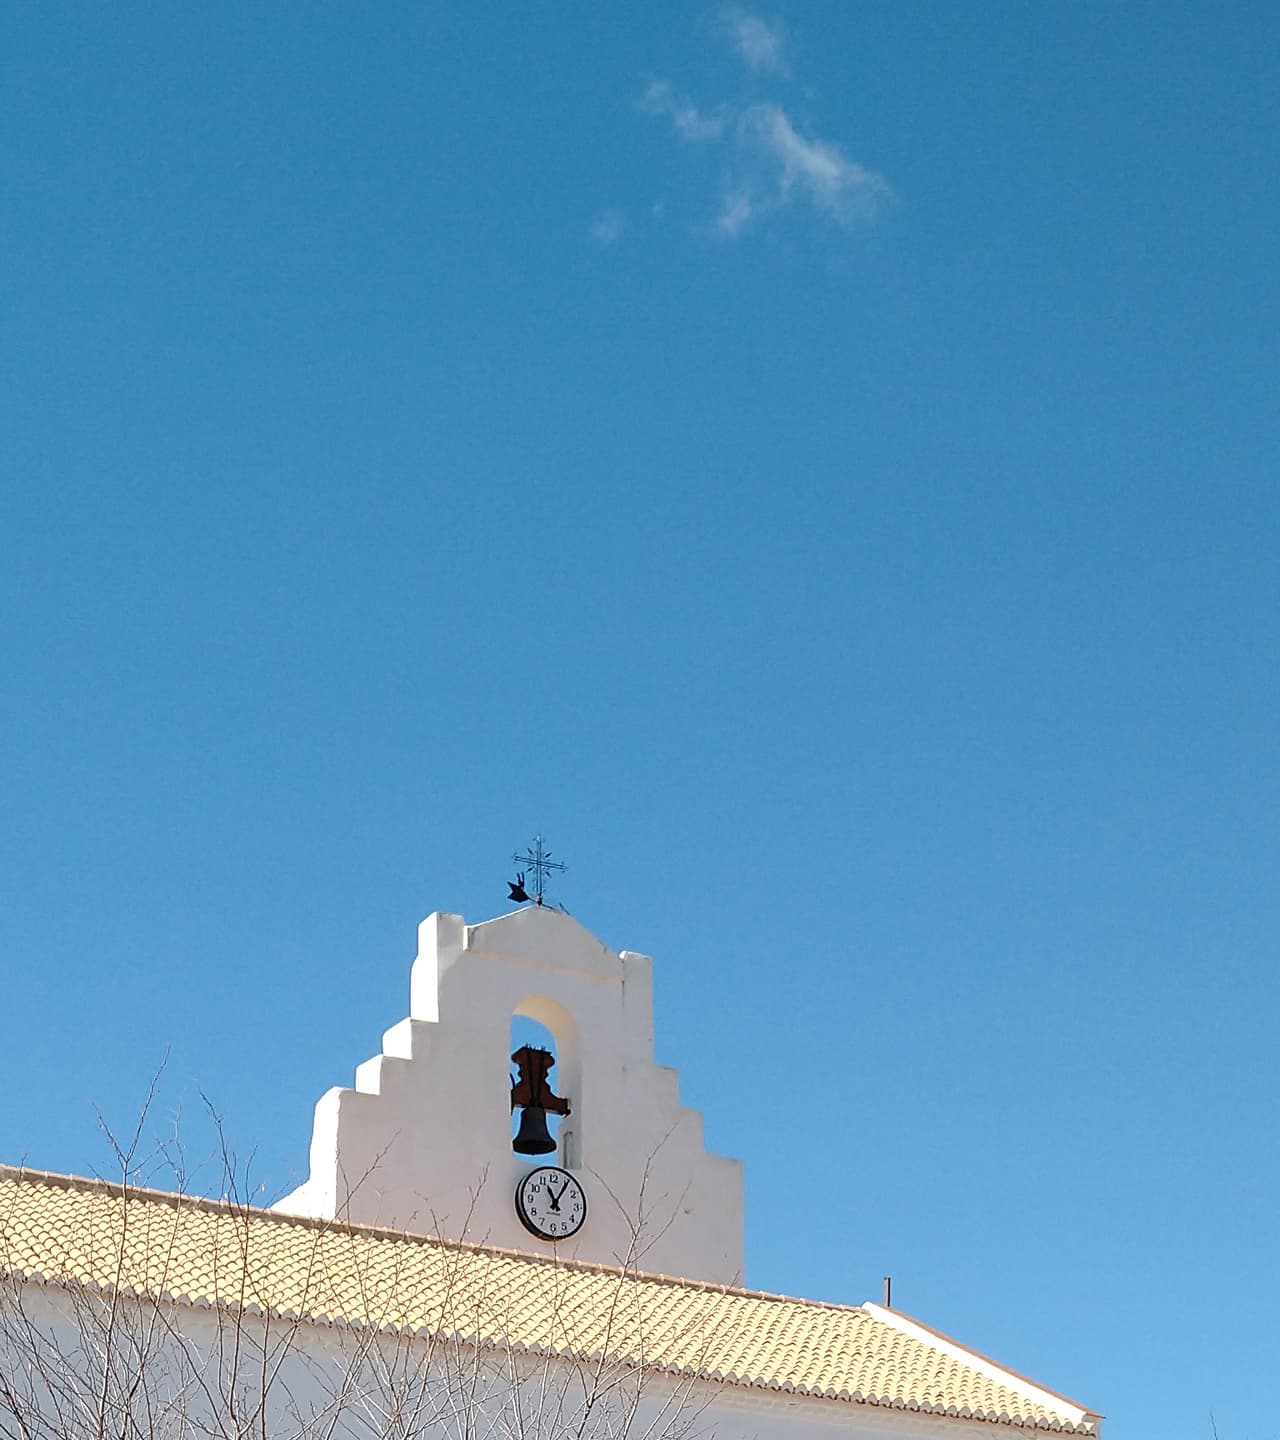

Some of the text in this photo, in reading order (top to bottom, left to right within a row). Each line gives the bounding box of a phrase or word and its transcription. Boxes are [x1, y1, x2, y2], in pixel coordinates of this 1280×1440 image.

[539, 1176, 546, 1186] 11
[549, 1174, 559, 1184] 12
[531, 1184, 541, 1193] 10
[528, 1194, 534, 1203] 9
[570, 1190, 577, 1199] 2
[530, 1207, 537, 1216] 8
[573, 1203, 580, 1212] 3
[538, 1217, 546, 1226] 7
[569, 1214, 575, 1223] 4
[550, 1223, 557, 1232] 6
[561, 1222, 568, 1231] 5
